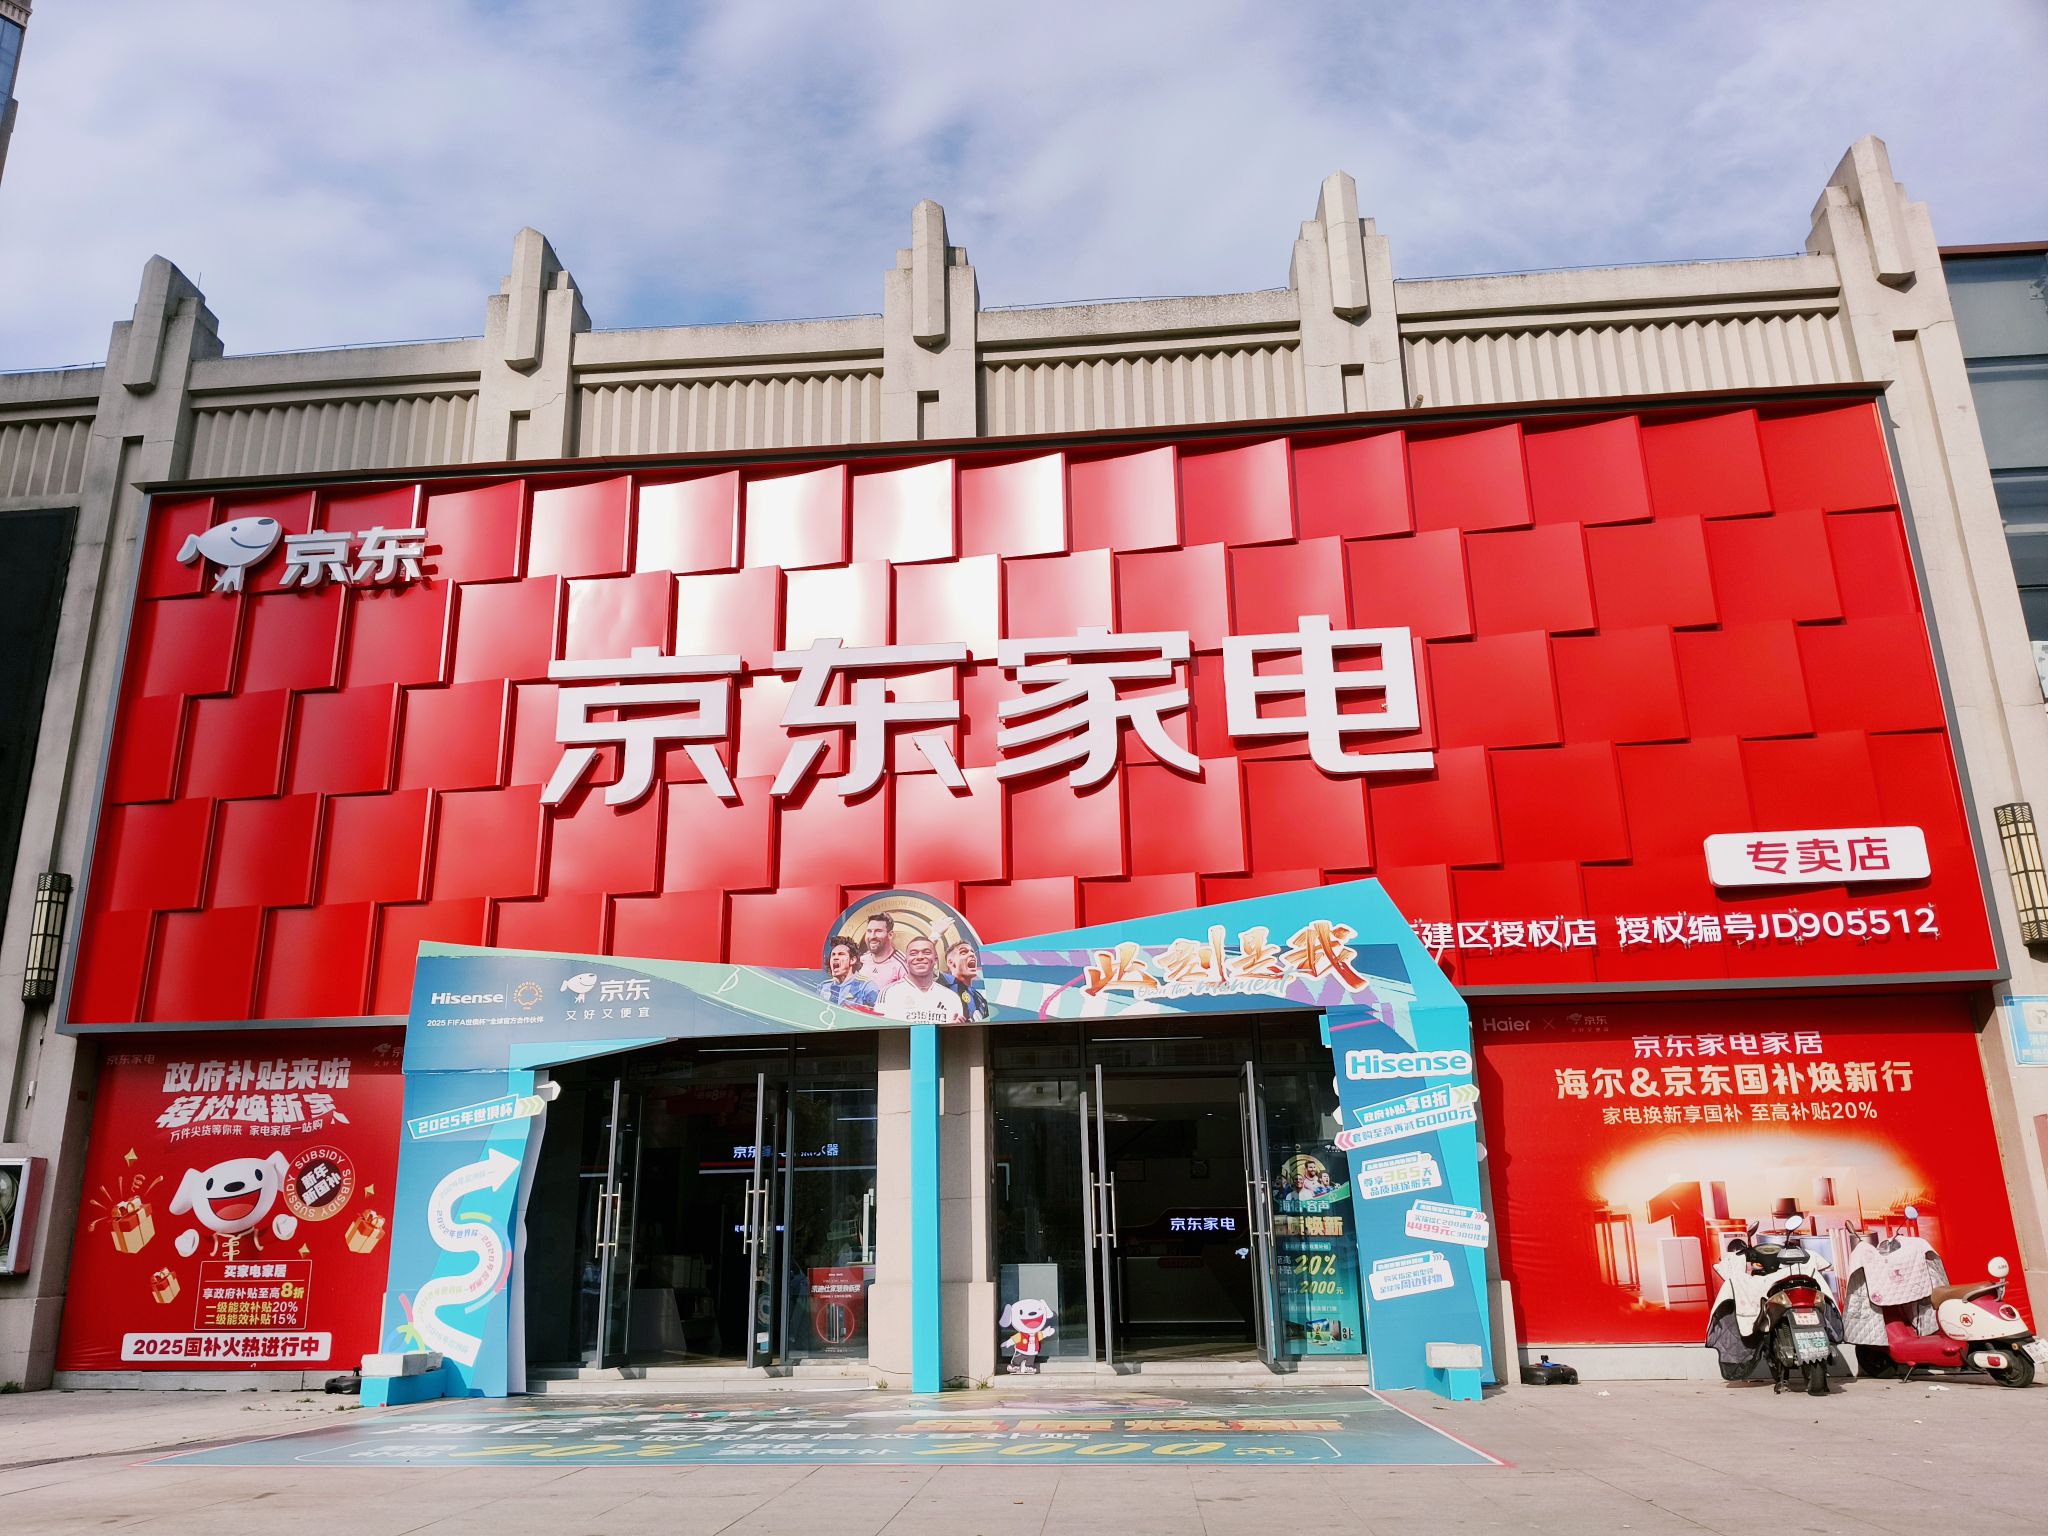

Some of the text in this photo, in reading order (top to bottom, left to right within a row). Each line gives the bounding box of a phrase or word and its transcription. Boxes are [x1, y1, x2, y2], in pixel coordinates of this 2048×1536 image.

[279, 526, 428, 587] 京东
[540, 615, 1434, 806] 京东家电
[1745, 836, 1890, 874] 专卖店
[1409, 906, 1938, 949] 建区授权店 授权编号JD905512
[600, 979, 651, 1002] 京东
[1168, 983, 1190, 996] the
[1196, 966, 1294, 994] moment
[431, 992, 504, 1005] Hisense
[427, 1019, 446, 1027] 2025
[565, 1007, 650, 1021] 又好又便宜
[1482, 1017, 1531, 1032] Haier
[1584, 1015, 1608, 1026] 京东
[1631, 1031, 1823, 1059] 京东家电家居
[106, 1054, 156, 1065] 京东家电
[1351, 1055, 1467, 1075] Hisense
[162, 1057, 351, 1092] 政府补贴来啦
[1555, 1060, 1914, 1100] 海尔&京东国补焕新行
[155, 1093, 350, 1129] 轻松焕新家
[418, 1101, 513, 1135] 2025年世俱杯
[1602, 1101, 1878, 1125] 家电换新享国补 至高补贴20%
[170, 1118, 323, 1143] 万件尖货等你来 家电家居一站购
[295, 1149, 345, 1169] SUBSIDY
[301, 1163, 329, 1190] 新年
[287, 1175, 315, 1217] SUBSIDY
[302, 1172, 341, 1206] 新国补
[321, 1169, 351, 1217] SUBSIDY
[437, 1209, 479, 1239] 2022年世界杯
[1170, 1217, 1236, 1231] 京东家电
[224, 1264, 287, 1278] 买家电家居
[1294, 1253, 1336, 1276] 20%
[203, 1281, 304, 1300] 享政府补贴至高8折
[206, 1301, 298, 1313] 一级能效补贴20%
[204, 1313, 297, 1325] 二级能效补贴15%
[133, 1336, 320, 1358] 2025国补火热进行中
[449, 1443, 704, 1457] 20%
